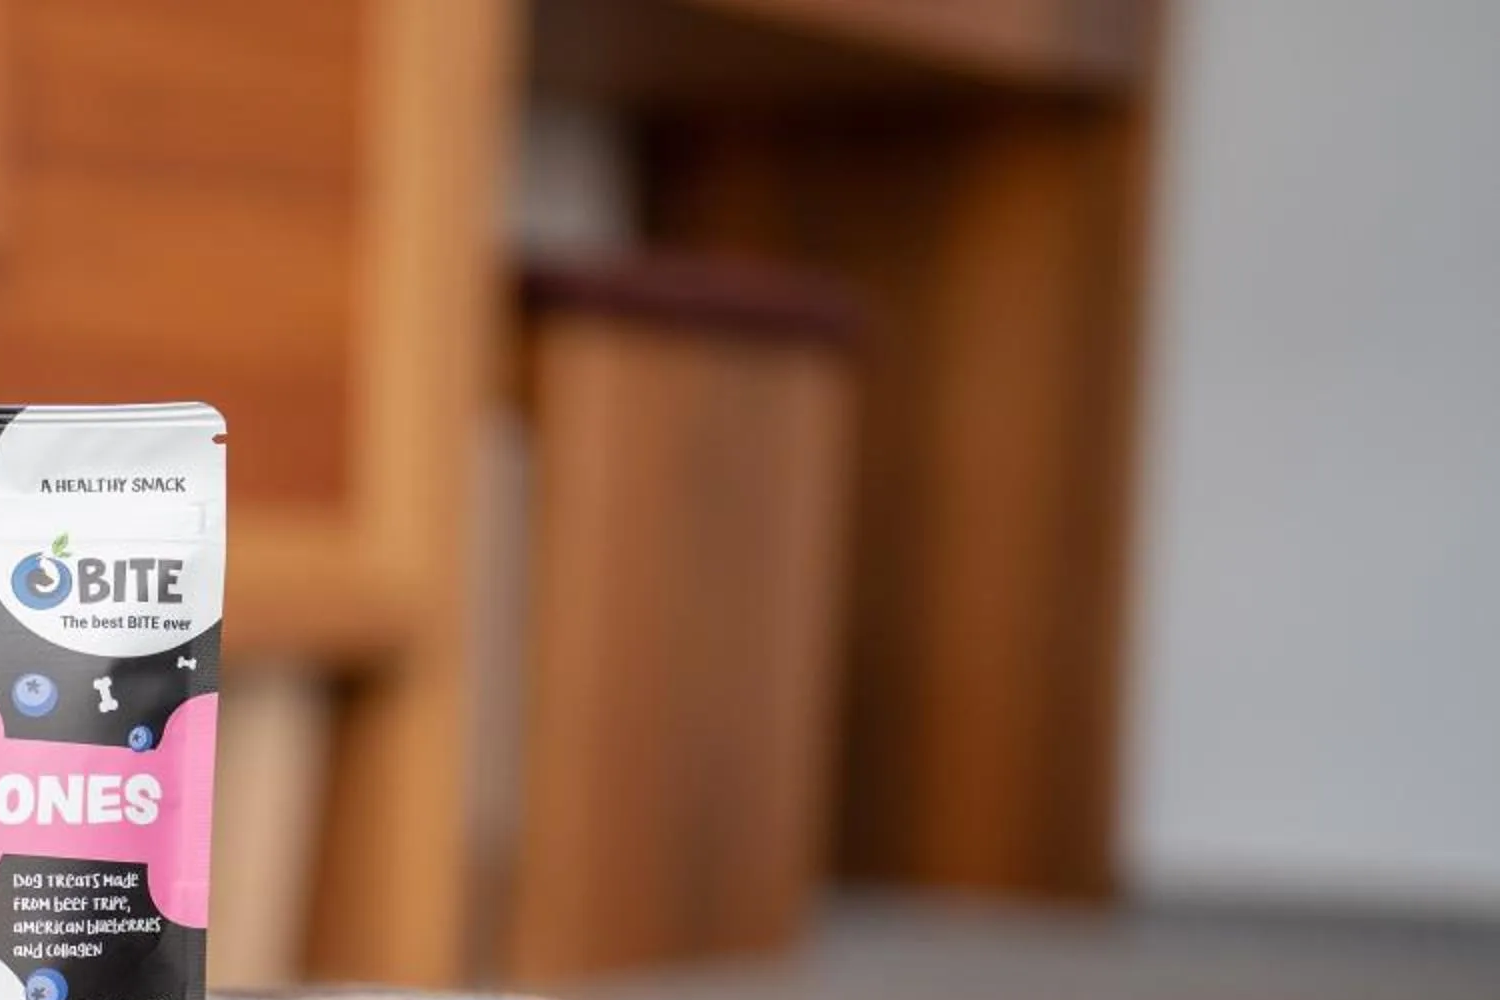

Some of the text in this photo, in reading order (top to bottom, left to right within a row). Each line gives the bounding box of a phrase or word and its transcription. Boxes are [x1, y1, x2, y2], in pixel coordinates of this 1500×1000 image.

[40, 476, 187, 493] A HEALTHY SNACK
[60, 614, 192, 631] The best BITE ever
